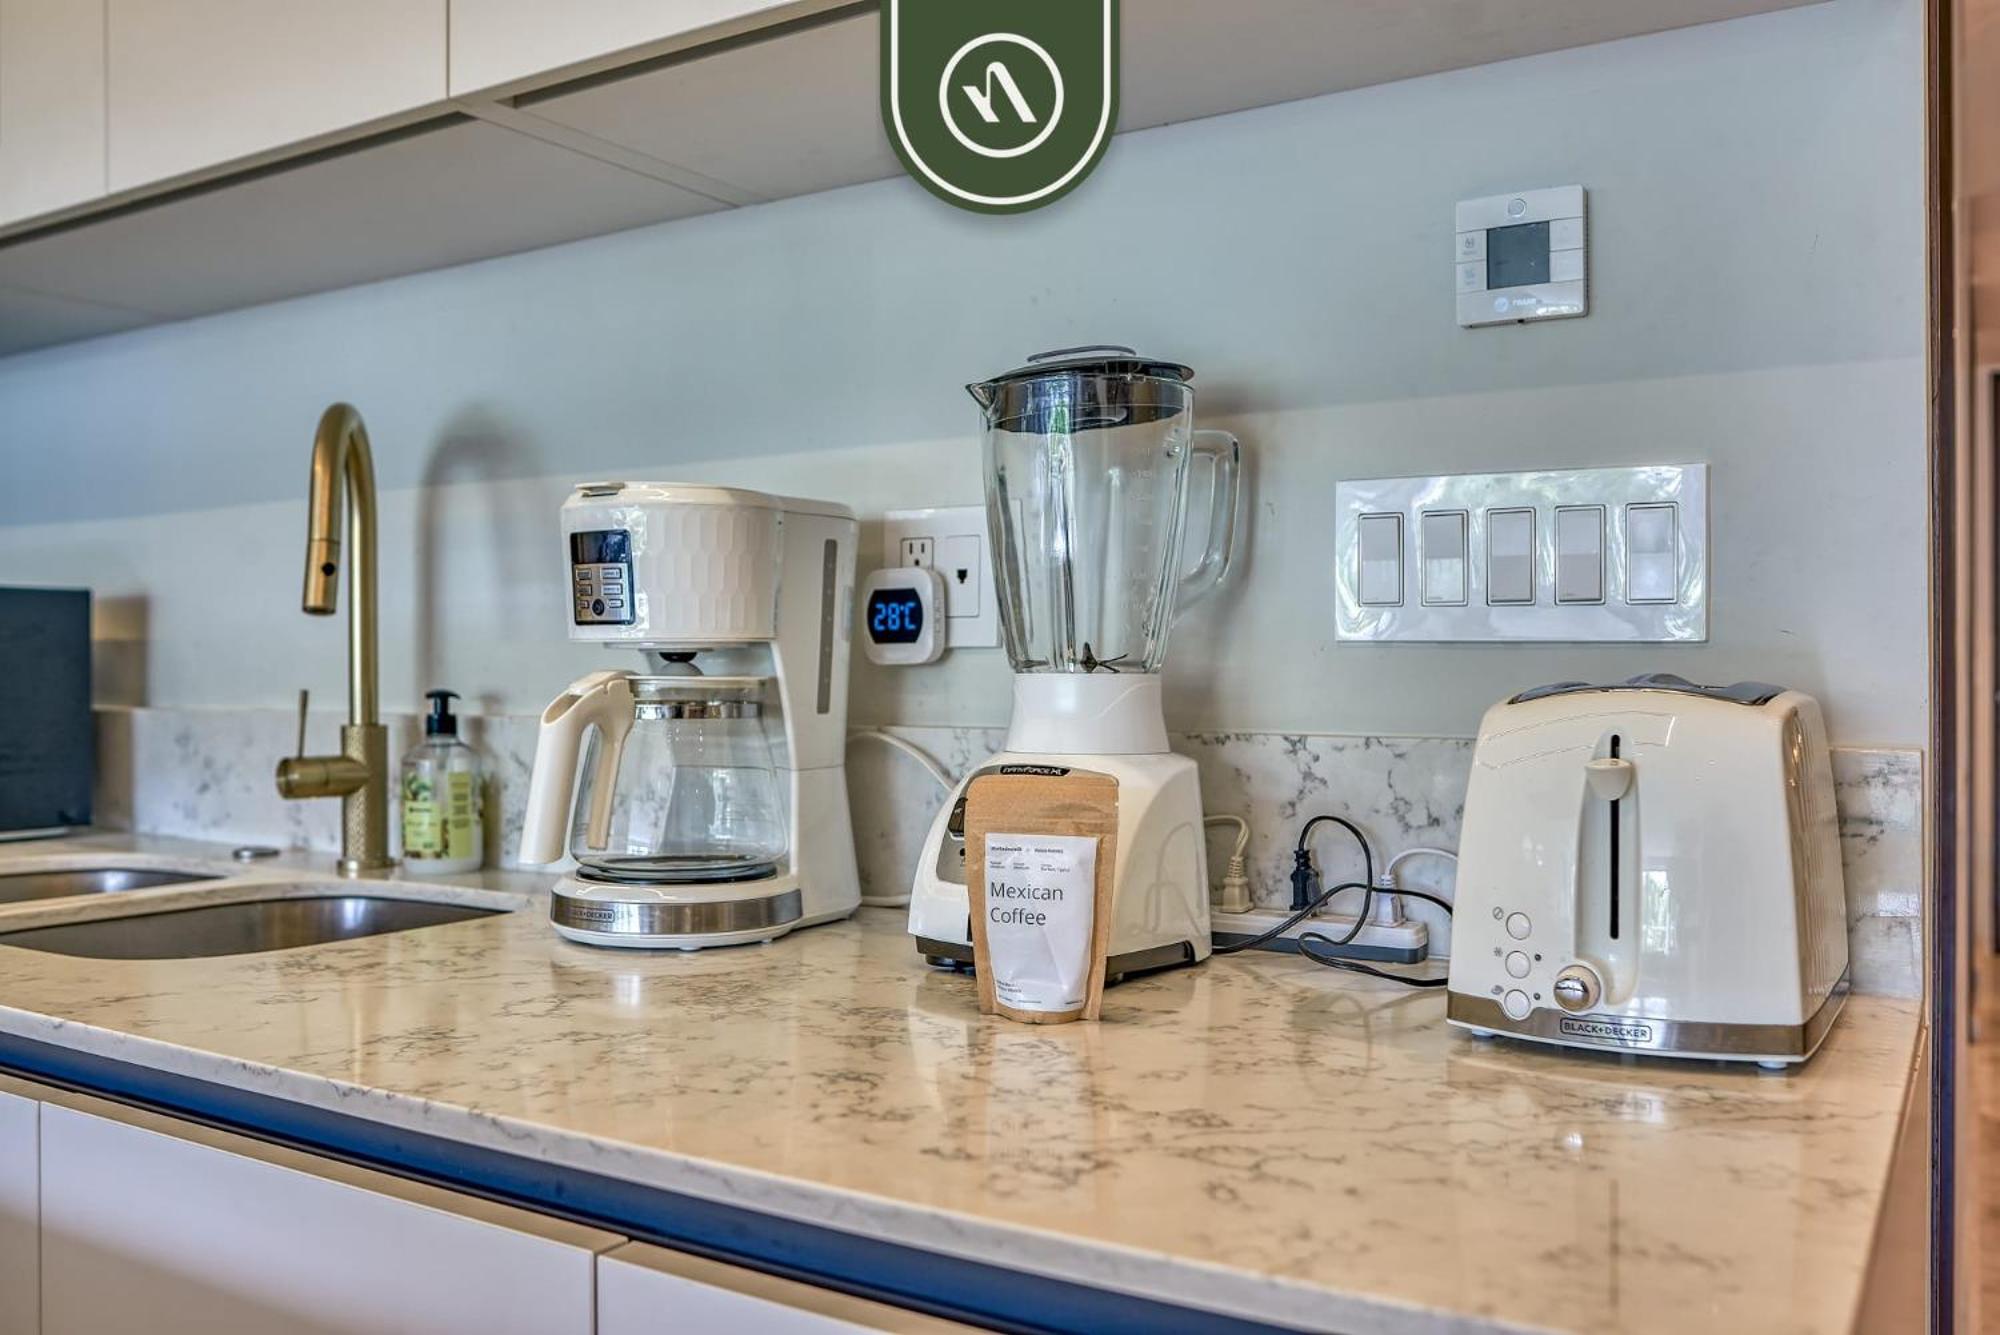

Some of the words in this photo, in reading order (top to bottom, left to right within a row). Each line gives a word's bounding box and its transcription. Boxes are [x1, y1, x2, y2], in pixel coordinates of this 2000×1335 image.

[991, 882, 1063, 900] Mexican
[990, 907, 1046, 925] Coffee
[1564, 1022, 1647, 1038] BLACK+DECKER
